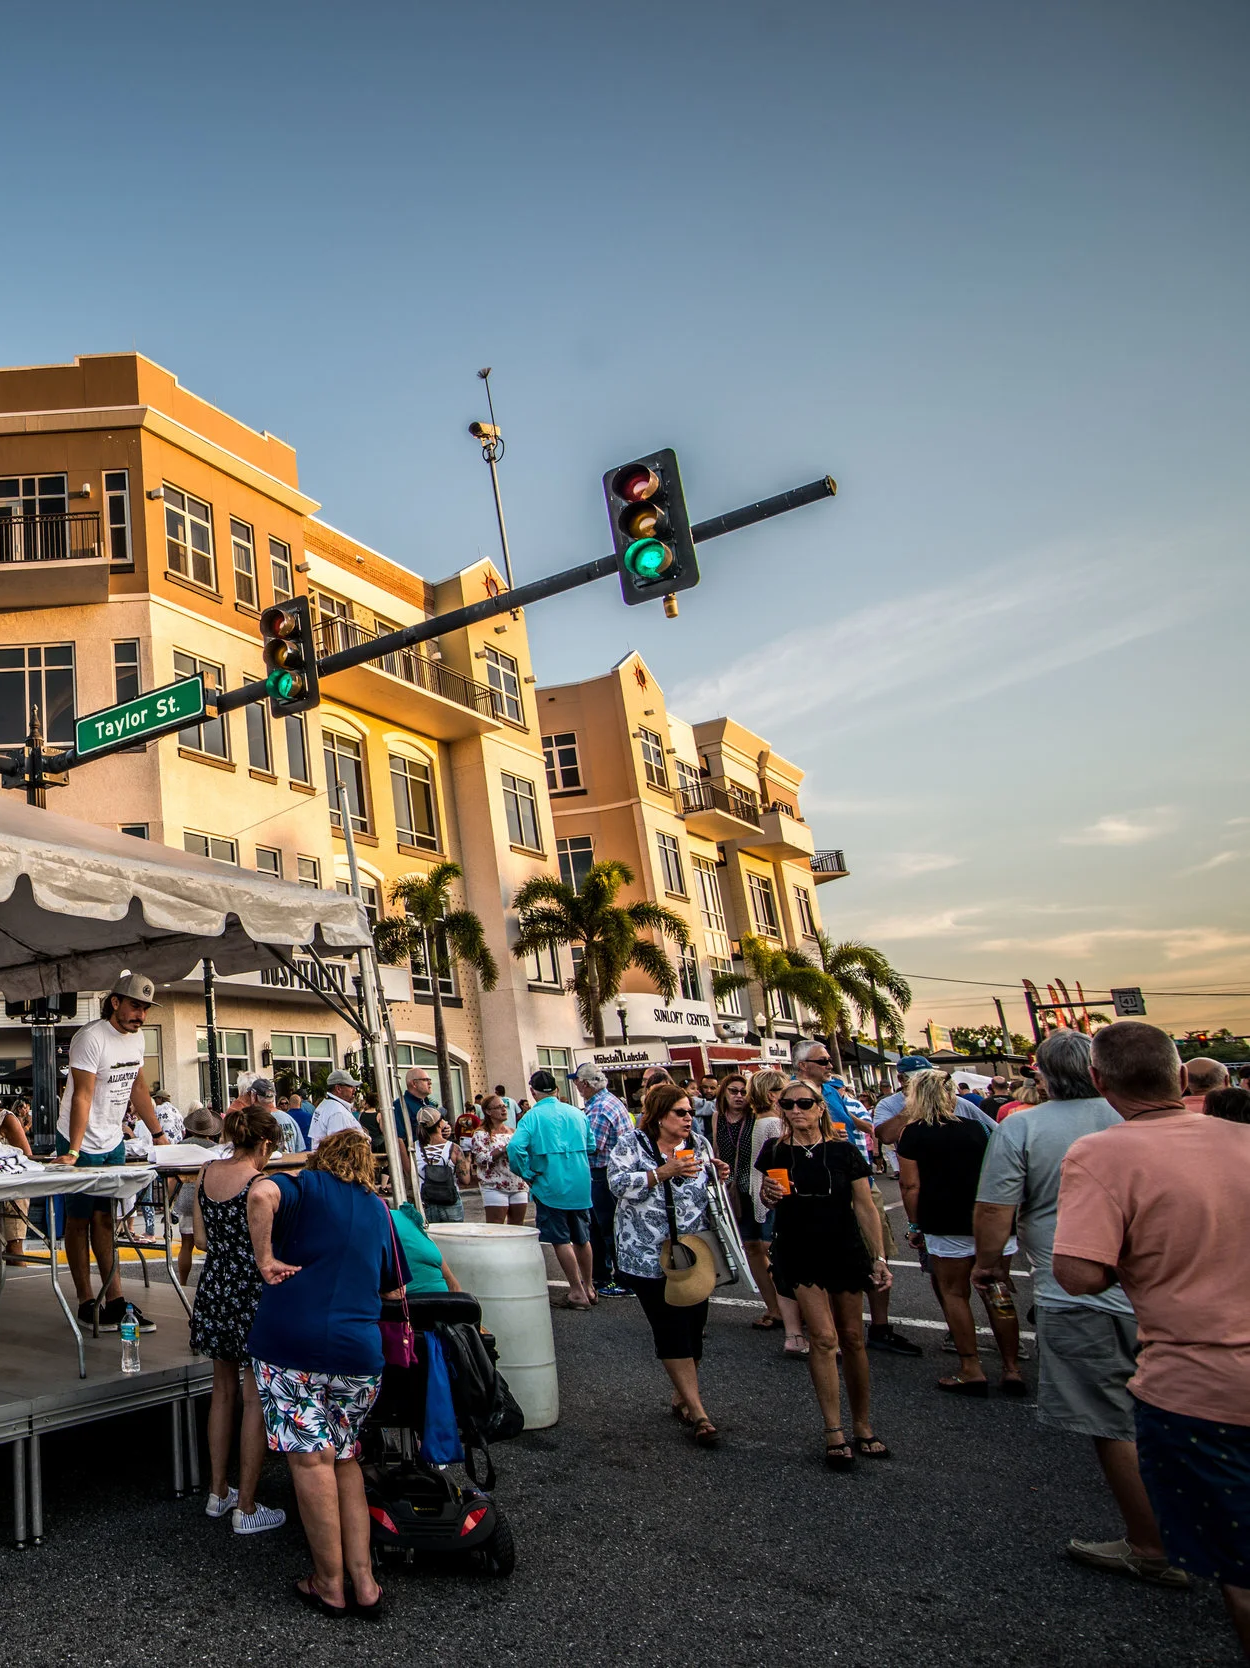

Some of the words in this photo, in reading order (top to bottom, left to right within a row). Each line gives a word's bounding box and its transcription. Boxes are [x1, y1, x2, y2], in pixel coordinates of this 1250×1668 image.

[95, 709, 148, 739] Taylor
[156, 696, 180, 717] St.
[653, 1008, 683, 1024] SUNLOFT
[686, 1012, 711, 1027] CENTER
[107, 1072, 134, 1084] ALLIGATOR
